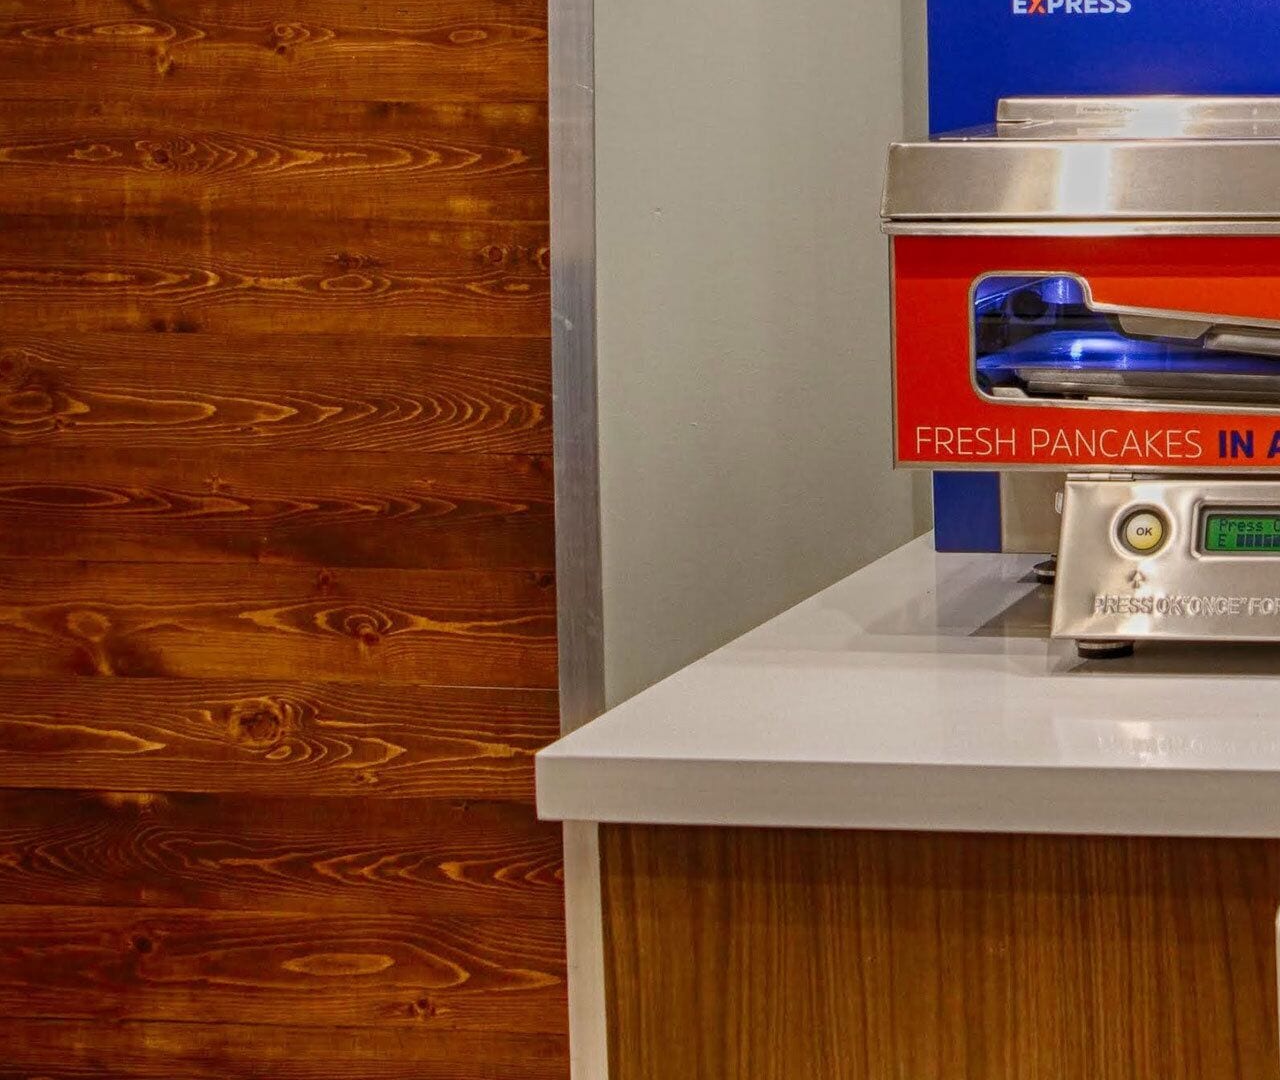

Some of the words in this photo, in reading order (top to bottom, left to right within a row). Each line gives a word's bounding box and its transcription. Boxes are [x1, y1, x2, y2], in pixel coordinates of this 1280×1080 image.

[916, 426, 1016, 455] FRESH
[1031, 428, 1203, 459] PANCAKES
[1218, 430, 1254, 458] IN
[1136, 526, 1153, 537] OK
[1219, 520, 1264, 532] Press
[1218, 534, 1226, 547] E
[1093, 596, 1153, 615] PRESS
